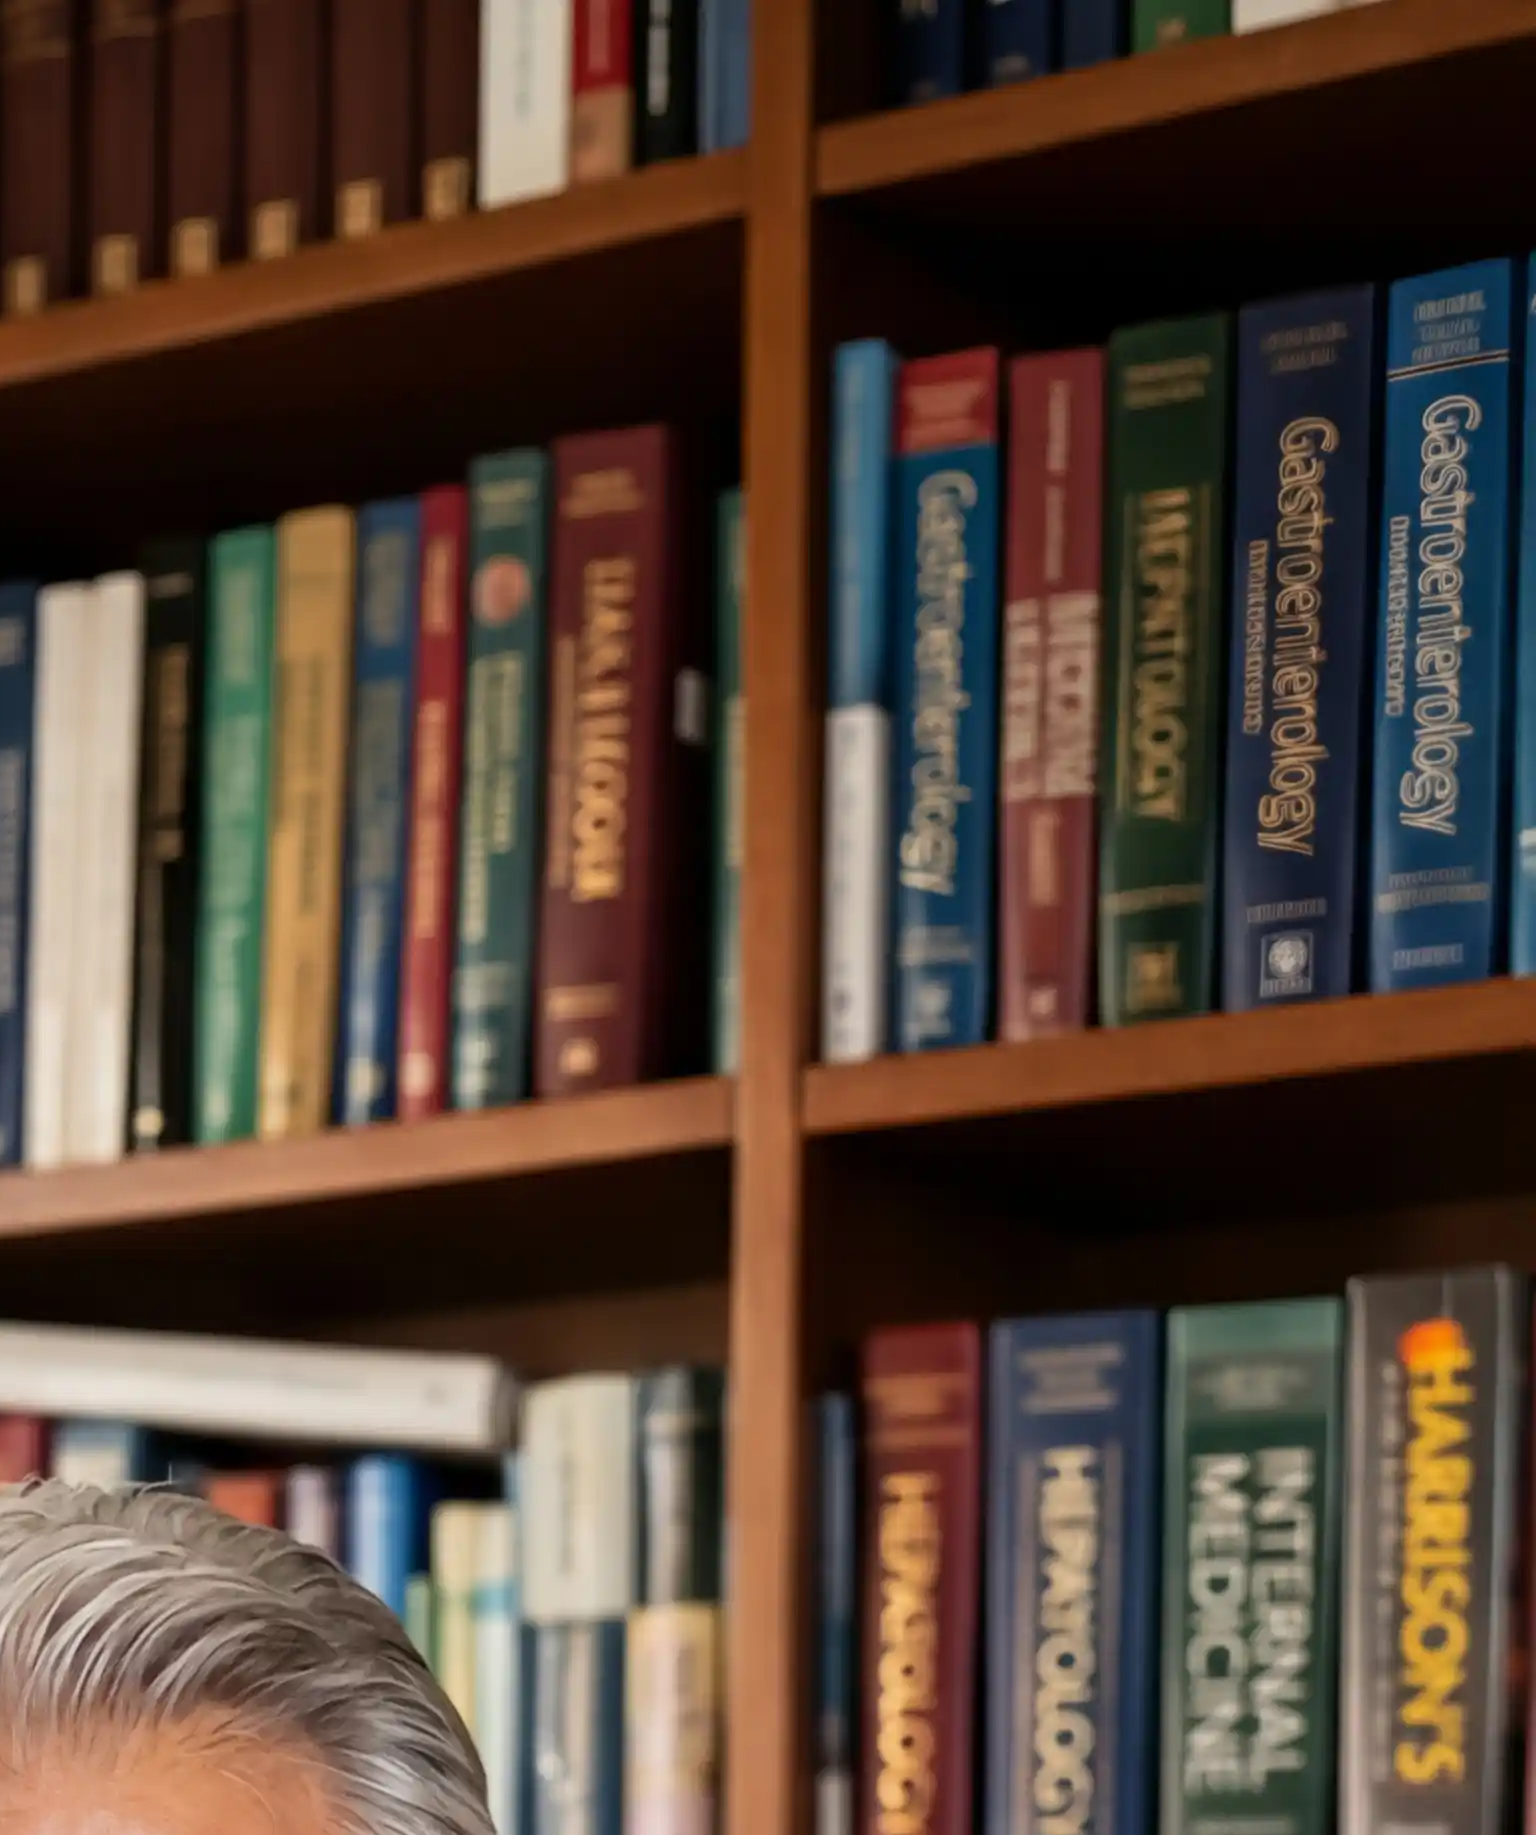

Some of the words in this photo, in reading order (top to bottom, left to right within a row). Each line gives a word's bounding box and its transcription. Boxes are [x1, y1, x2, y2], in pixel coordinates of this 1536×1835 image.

[1257, 416, 1338, 855] Gastroenterology
[1399, 394, 1483, 835] Gastroenterology
[1186, 1454, 1252, 1794] MEDICINE
[1250, 1447, 1314, 1776] INTERNAL
